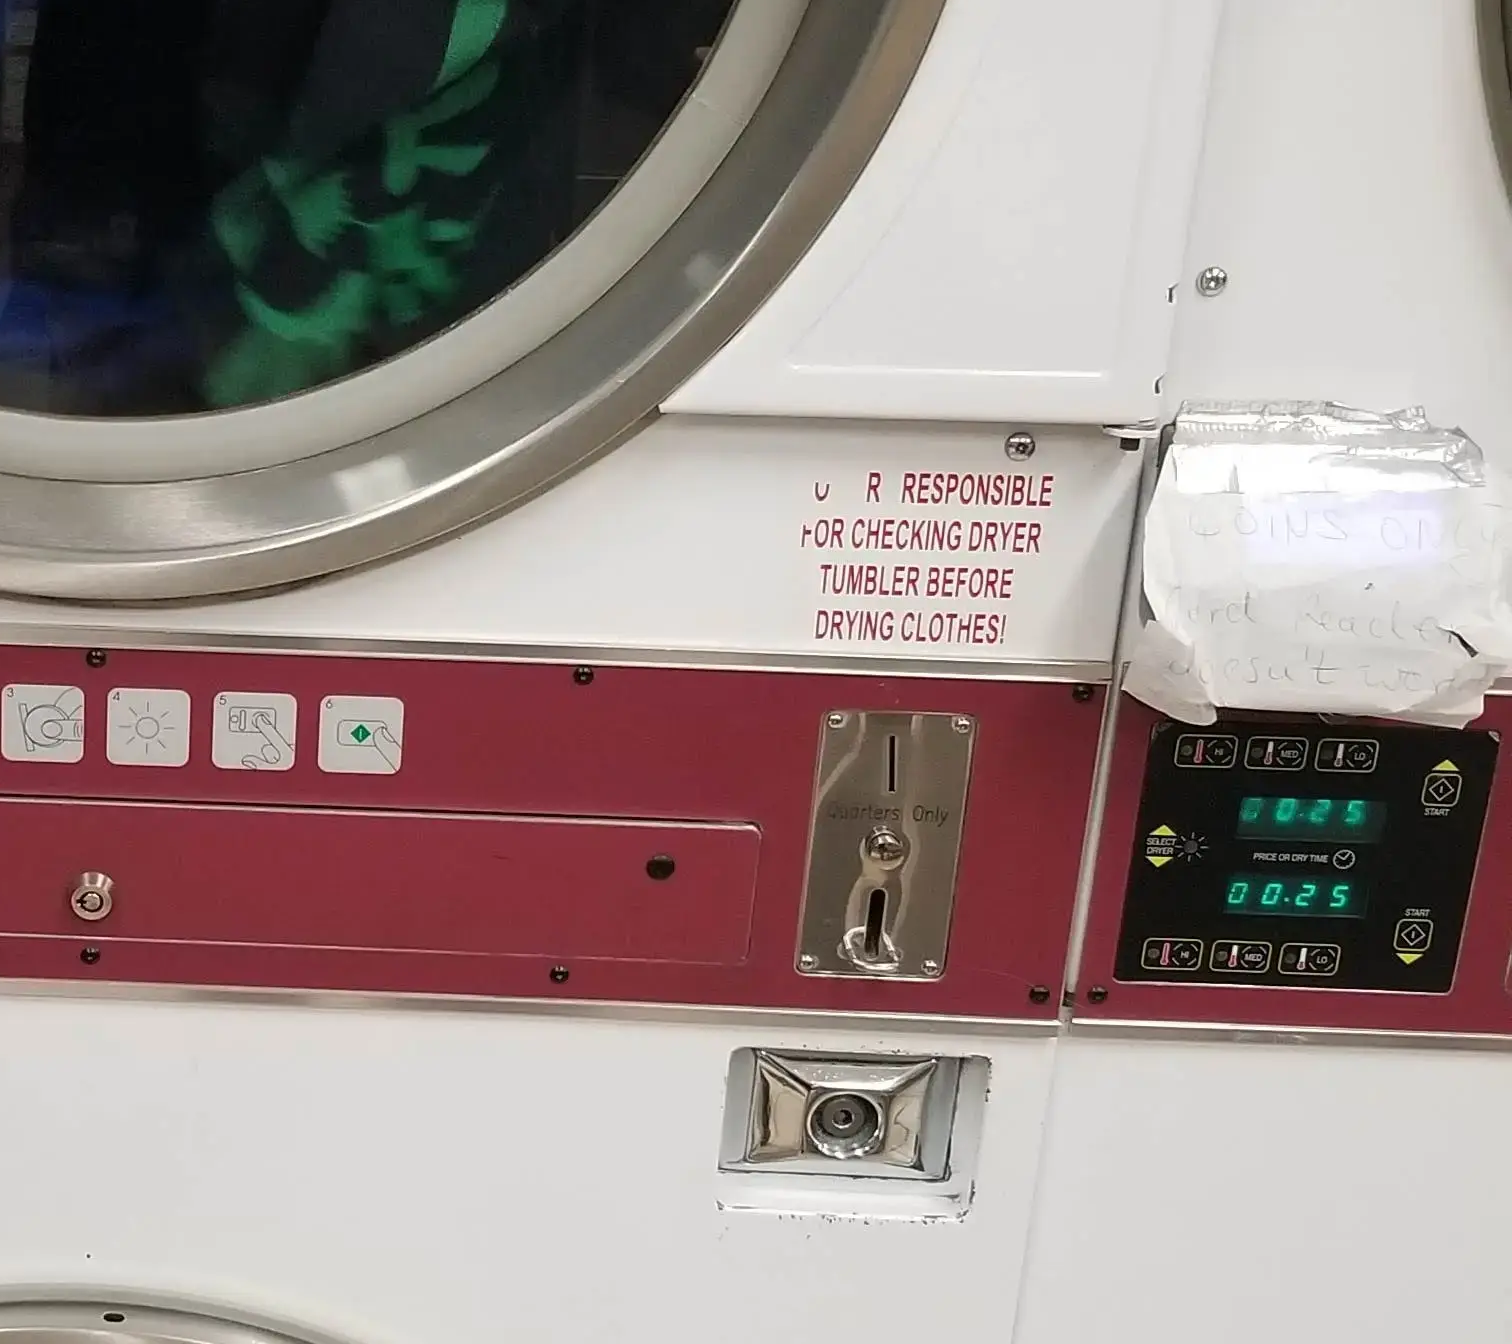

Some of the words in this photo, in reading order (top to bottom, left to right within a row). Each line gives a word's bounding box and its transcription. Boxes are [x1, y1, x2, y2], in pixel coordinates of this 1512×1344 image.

[902, 472, 1055, 507] RESPONSIBLE
[851, 518, 962, 552] CHECKING
[968, 521, 1042, 554] DRYER
[820, 564, 920, 597] TUMBLER
[926, 567, 1014, 599] BEFORE
[815, 609, 894, 642] DRYING
[901, 612, 1007, 645] CLOTHES!
[6, 687, 14, 698] 3
[112, 691, 120, 701] 4
[219, 695, 227, 705] 5
[325, 699, 333, 709] 6
[1281, 749, 1299, 759] MED
[1354, 752, 1366, 761] LO
[913, 805, 948, 827] Only
[1424, 807, 1451, 816] START
[1146, 837, 1177, 846] SELECT
[1146, 846, 1174, 855] DRYER
[1252, 852, 1277, 862] PRICE
[1278, 853, 1290, 862] OR
[1291, 854, 1310, 862] DRY
[1310, 855, 1329, 863] TIME
[1404, 908, 1431, 918] START
[1245, 953, 1262, 962] MED
[1316, 956, 1328, 965] LO
